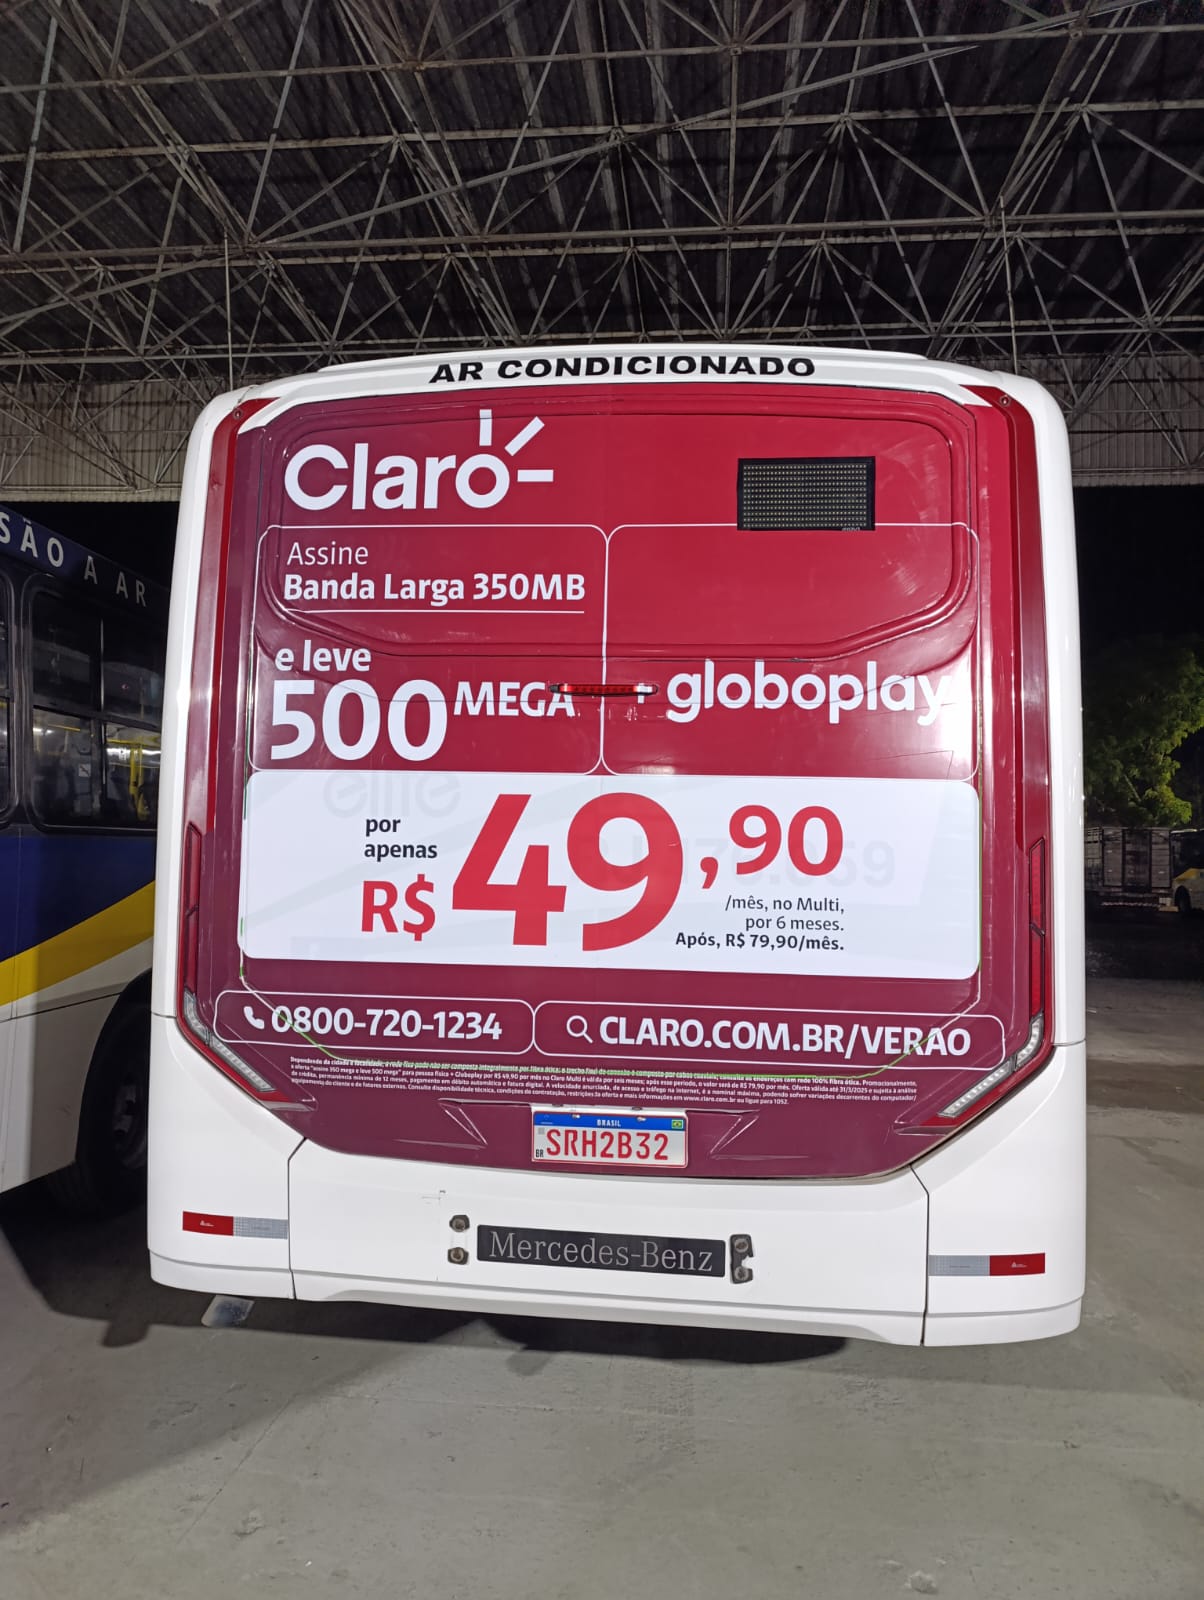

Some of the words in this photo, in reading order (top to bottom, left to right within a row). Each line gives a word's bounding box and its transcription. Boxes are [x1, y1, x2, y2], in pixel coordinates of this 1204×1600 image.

[430, 361, 483, 383] AR
[498, 355, 815, 380] CONDICIONADO
[284, 442, 510, 510] Claro
[286, 541, 369, 566] Assine
[84, 555, 98, 585] A
[115, 571, 147, 607] AR
[284, 574, 376, 601] Banda
[384, 574, 464, 606] Larga
[473, 573, 586, 601] 350MB
[275, 649, 296, 672] e
[303, 640, 371, 672] leve
[667, 658, 952, 726] globoplay
[270, 679, 448, 761] 500
[454, 681, 576, 717] MEGA
[365, 817, 401, 837] por
[364, 844, 438, 862] apenas
[361, 873, 436, 942] R$
[725, 895, 769, 912] /mês,
[772, 899, 794, 911] no
[796, 897, 845, 914] Multi,
[745, 917, 772, 932] por
[776, 916, 786, 930] 6
[790, 920, 845, 932] meses.
[675, 932, 721, 950] Após,
[725, 933, 746, 949] R$
[750, 934, 845, 952] 79,90/mês.
[271, 1005, 503, 1040] 0800-720-1234
[599, 1016, 971, 1060] CLARO.COM.BR/VERAO
[596, 1119, 621, 1127] BRASIL
[535, 1149, 544, 1158] BR
[546, 1129, 669, 1161] SRH2B32
[489, 1231, 713, 1272] Mercedes-Benz
